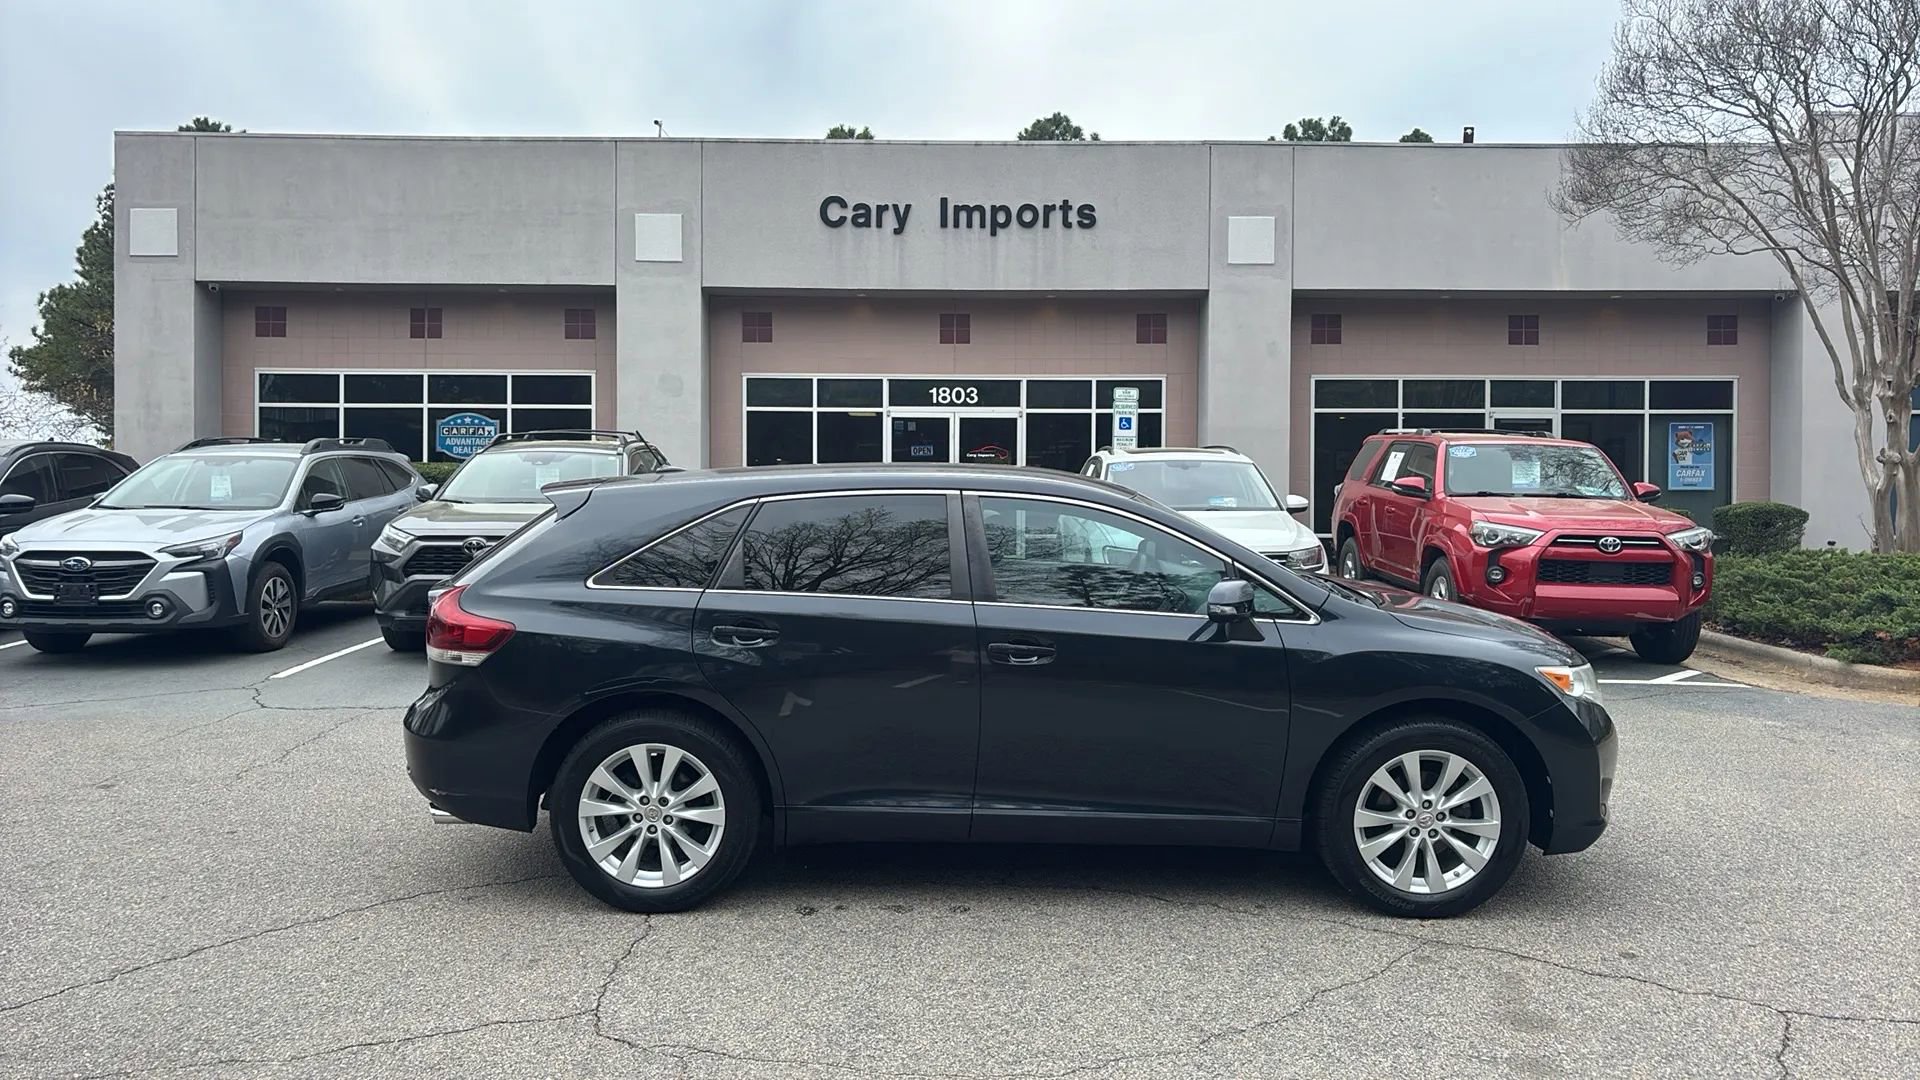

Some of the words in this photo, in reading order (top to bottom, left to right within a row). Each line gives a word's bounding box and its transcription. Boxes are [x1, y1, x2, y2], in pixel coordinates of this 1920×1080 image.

[819, 195, 912, 235] Cary
[940, 197, 1097, 236] Imports
[928, 386, 979, 404] 1803
[442, 427, 493, 436] CARFAX
[445, 437, 491, 446] ADVANTAGE
[912, 447, 932, 456] OPEN
[1676, 469, 1706, 477] CARFAX
